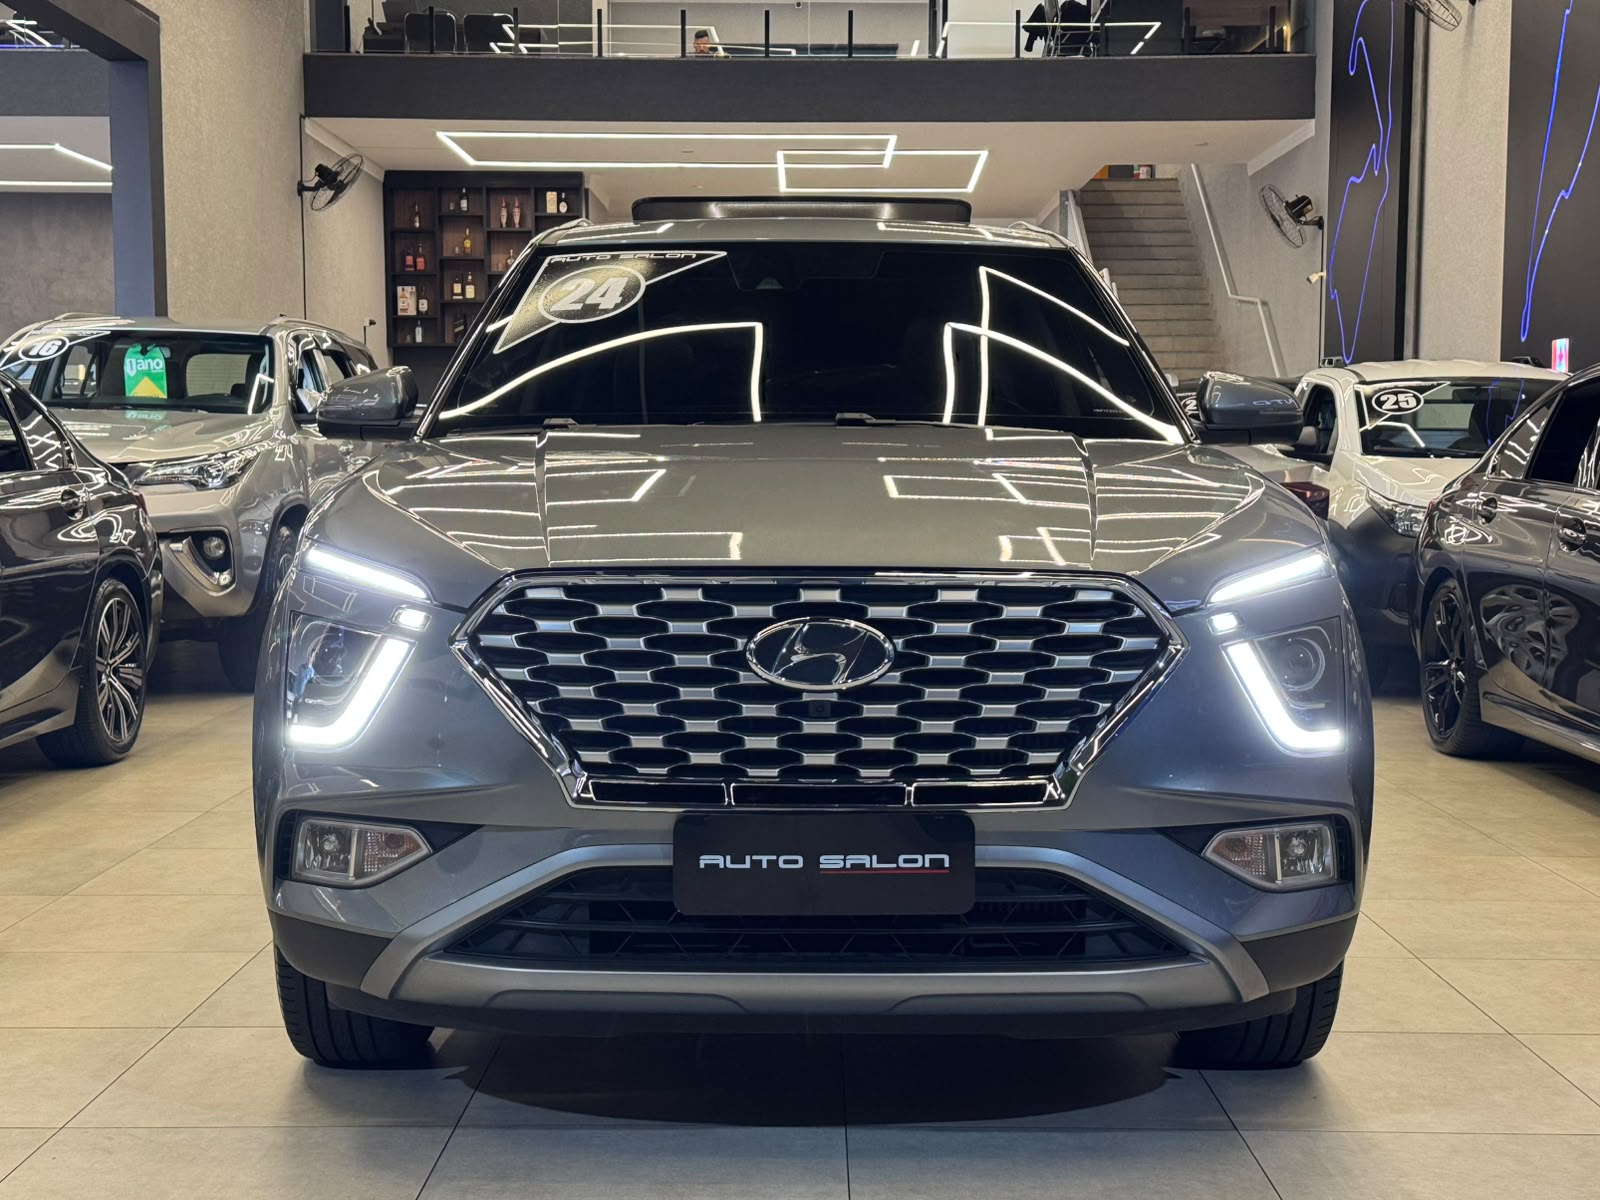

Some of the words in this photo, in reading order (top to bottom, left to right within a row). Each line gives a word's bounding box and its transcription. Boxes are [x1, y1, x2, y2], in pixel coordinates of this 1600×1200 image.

[551, 254, 611, 263] AUTO
[550, 276, 629, 312] 24
[28, 340, 63, 356] 16
[1186, 399, 1197, 410] 2
[1380, 393, 1418, 410] 25
[699, 854, 804, 869] AUTO
[819, 854, 949, 869] SALON
